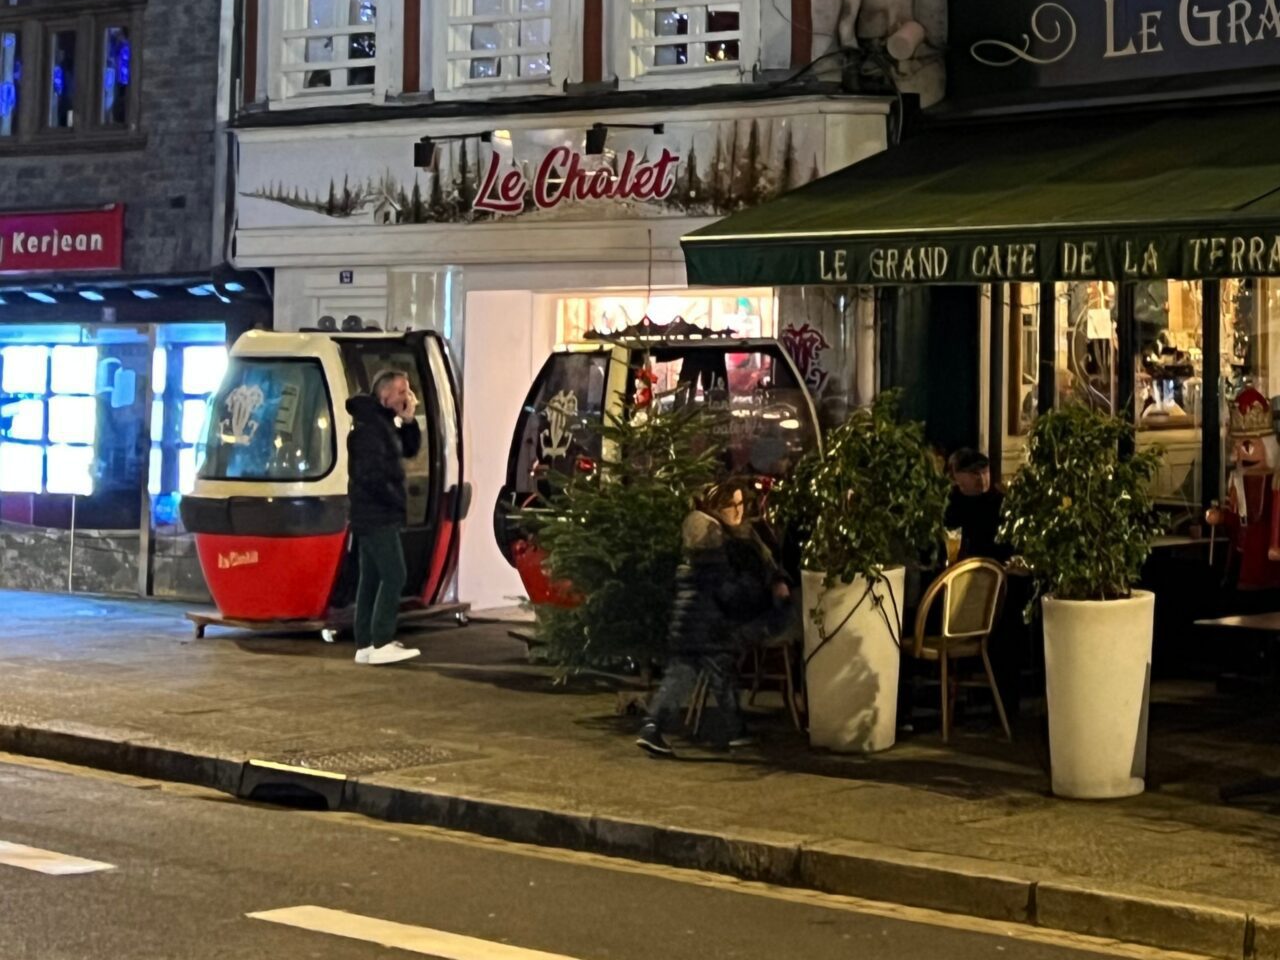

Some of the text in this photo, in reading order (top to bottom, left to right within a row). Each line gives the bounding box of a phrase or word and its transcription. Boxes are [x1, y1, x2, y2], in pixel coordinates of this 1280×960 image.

[473, 145, 680, 214] Le Chalet
[12, 228, 103, 256] Kerjean
[819, 249, 848, 281] LE
[869, 246, 948, 280] GRAND
[971, 243, 1036, 278] CAFE
[1063, 241, 1097, 275] DE
[1124, 240, 1158, 273] LA
